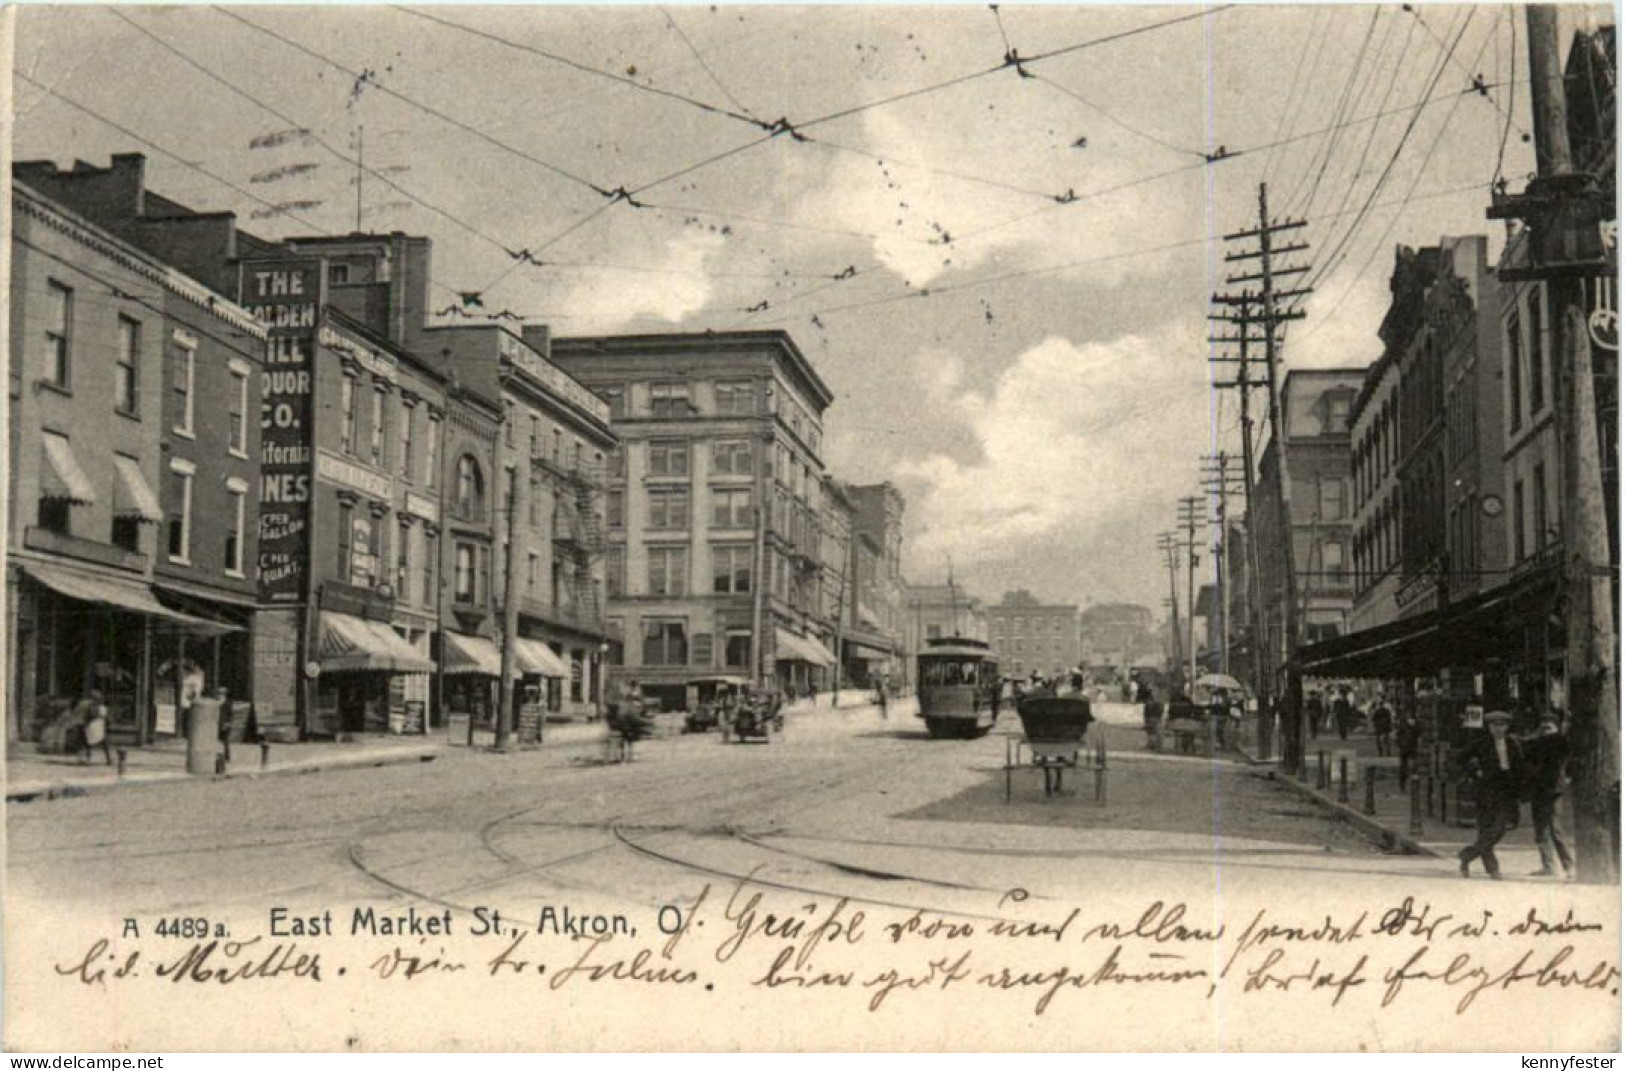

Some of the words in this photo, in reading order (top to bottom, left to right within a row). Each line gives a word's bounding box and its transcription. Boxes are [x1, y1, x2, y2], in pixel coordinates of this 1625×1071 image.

[255, 271, 303, 296] THE
[246, 303, 315, 328] OLDEN
[266, 336, 305, 364] ILL
[262, 370, 310, 400] QUOR
[262, 441, 311, 465] ifornia
[259, 474, 309, 503] INES
[122, 918, 140, 938] A
[270, 908, 332, 936] East
[351, 907, 452, 936] Market
[537, 907, 637, 938] Akron,
